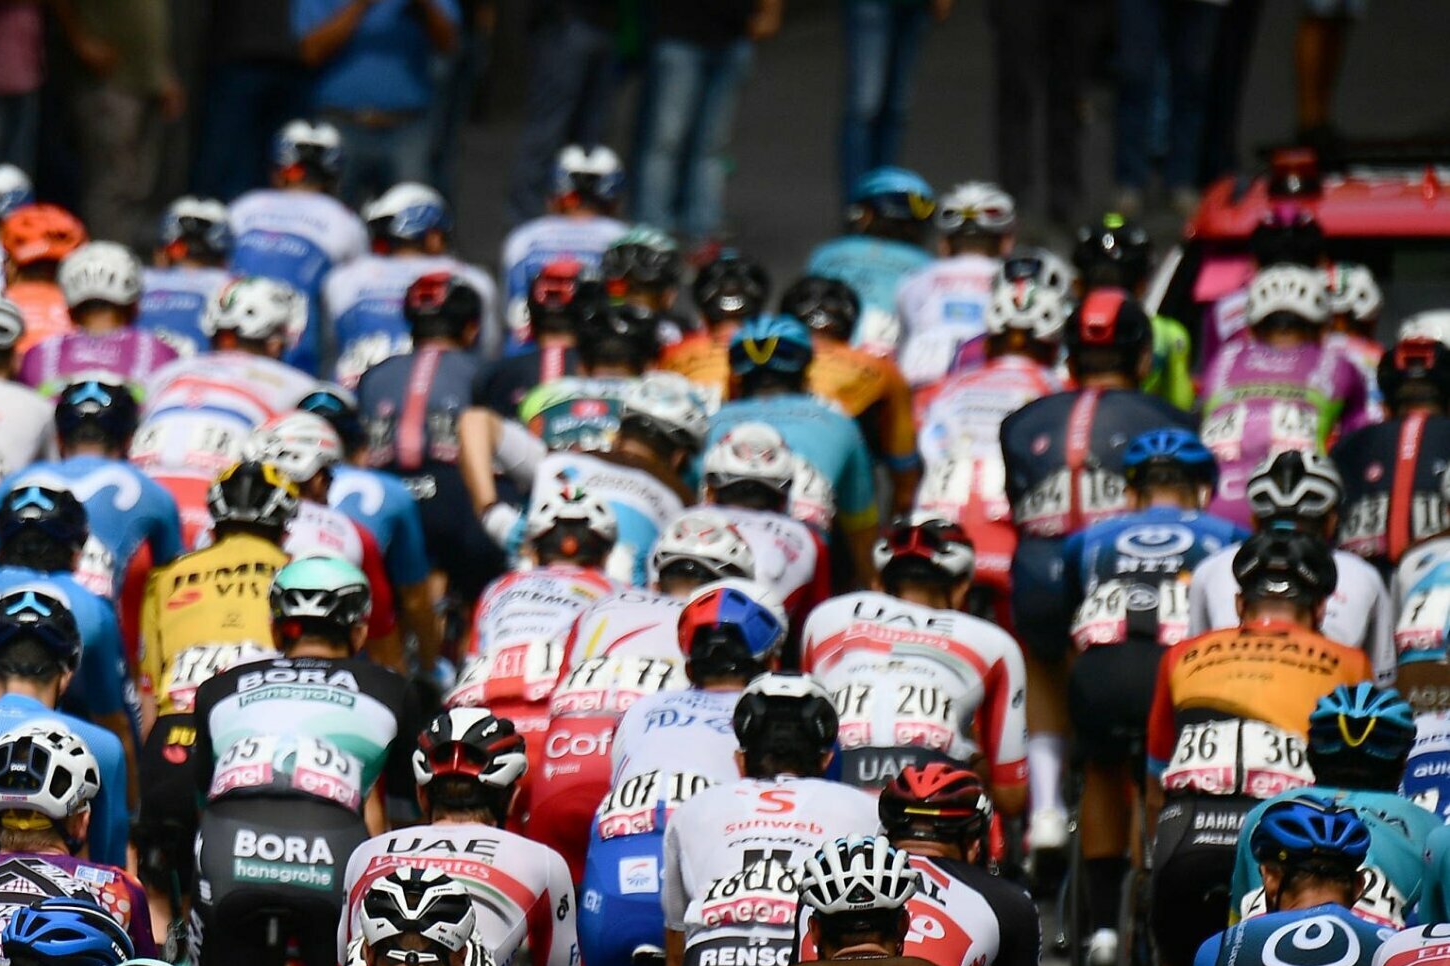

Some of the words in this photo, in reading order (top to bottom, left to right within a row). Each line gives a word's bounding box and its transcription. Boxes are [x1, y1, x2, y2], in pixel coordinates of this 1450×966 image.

[237, 668, 360, 693] BORA
[1179, 728, 1219, 763] 36
[724, 819, 823, 836] sunweb
[234, 830, 334, 864] BORA
[387, 837, 501, 857] UAE
[234, 861, 332, 886] hansgrohe
[700, 947, 792, 966] RENSO
